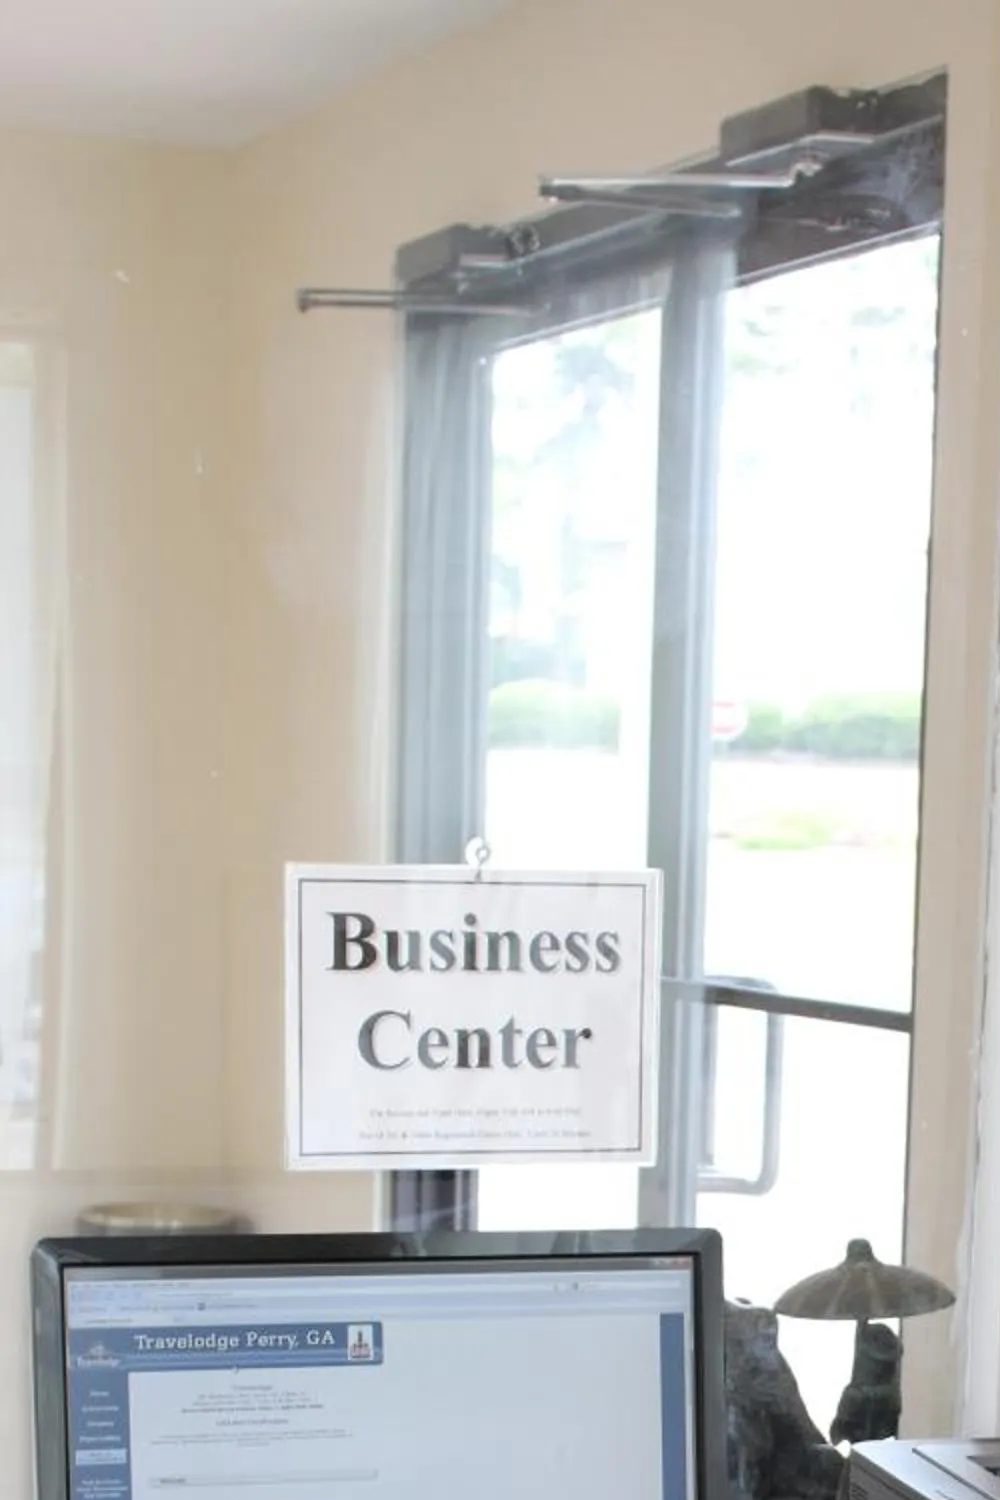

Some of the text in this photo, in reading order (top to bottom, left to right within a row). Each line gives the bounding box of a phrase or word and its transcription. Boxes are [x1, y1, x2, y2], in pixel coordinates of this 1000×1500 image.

[325, 911, 621, 974] Business
[357, 1009, 593, 1071] Center
[134, 1330, 336, 1351] Travelodge Perry, GA
